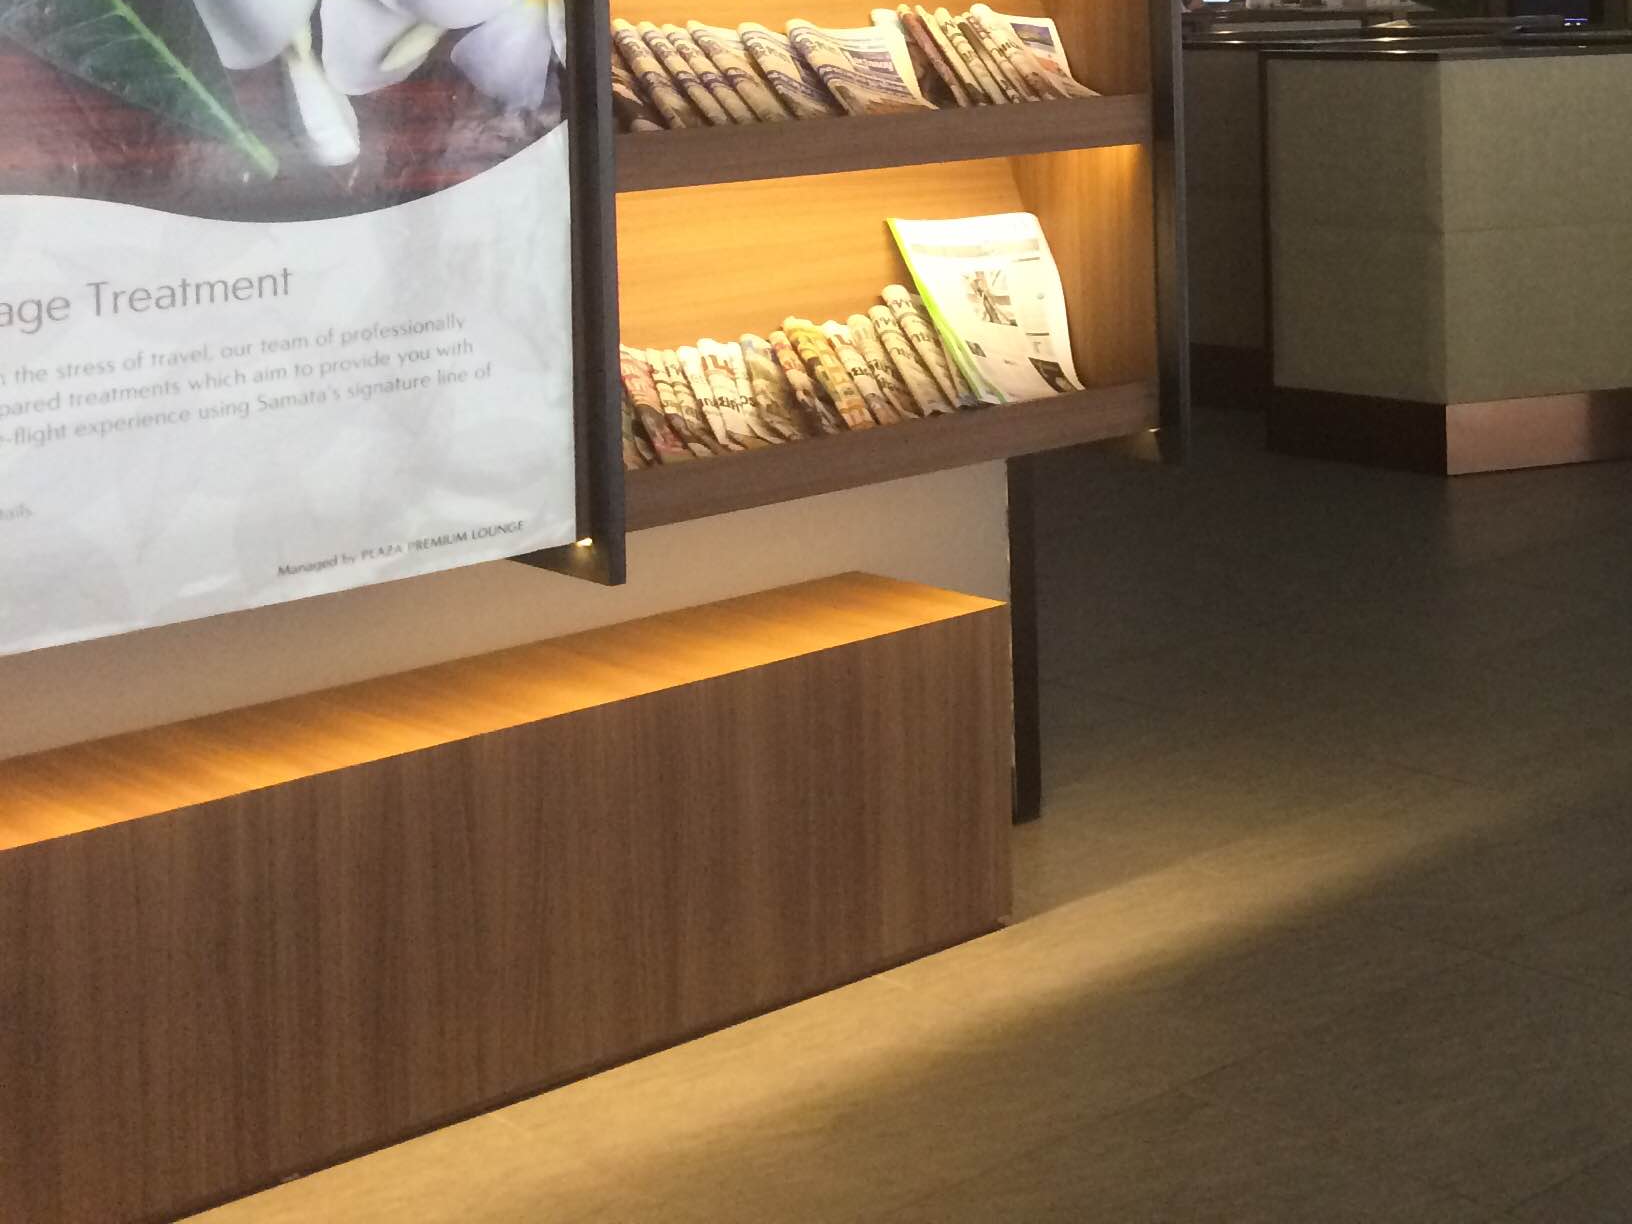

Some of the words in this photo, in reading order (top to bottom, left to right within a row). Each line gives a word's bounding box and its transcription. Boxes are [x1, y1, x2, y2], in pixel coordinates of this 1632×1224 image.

[85, 267, 293, 317] Treatment
[14, 365, 49, 385] the
[55, 359, 116, 382] stress
[122, 350, 144, 372] of
[219, 343, 254, 359] our
[260, 335, 309, 355] team
[315, 329, 336, 348] of
[340, 312, 466, 347] professionally
[69, 378, 181, 408] treatments
[188, 367, 247, 392] which
[252, 364, 288, 384] aim
[294, 362, 313, 378] to
[319, 351, 391, 377] provide
[396, 350, 431, 368] you
[435, 338, 474, 357] with
[73, 406, 191, 440] experience
[198, 398, 250, 422] using
[257, 385, 341, 413] Samata's
[346, 373, 432, 402] signature
[437, 368, 468, 386] line
[474, 361, 493, 379] of
[277, 555, 339, 576] Managed
[342, 552, 357, 566] by
[360, 543, 403, 561] PLAZA
[407, 531, 468, 553] PREMIUM
[471, 520, 526, 541] LOUNGE
